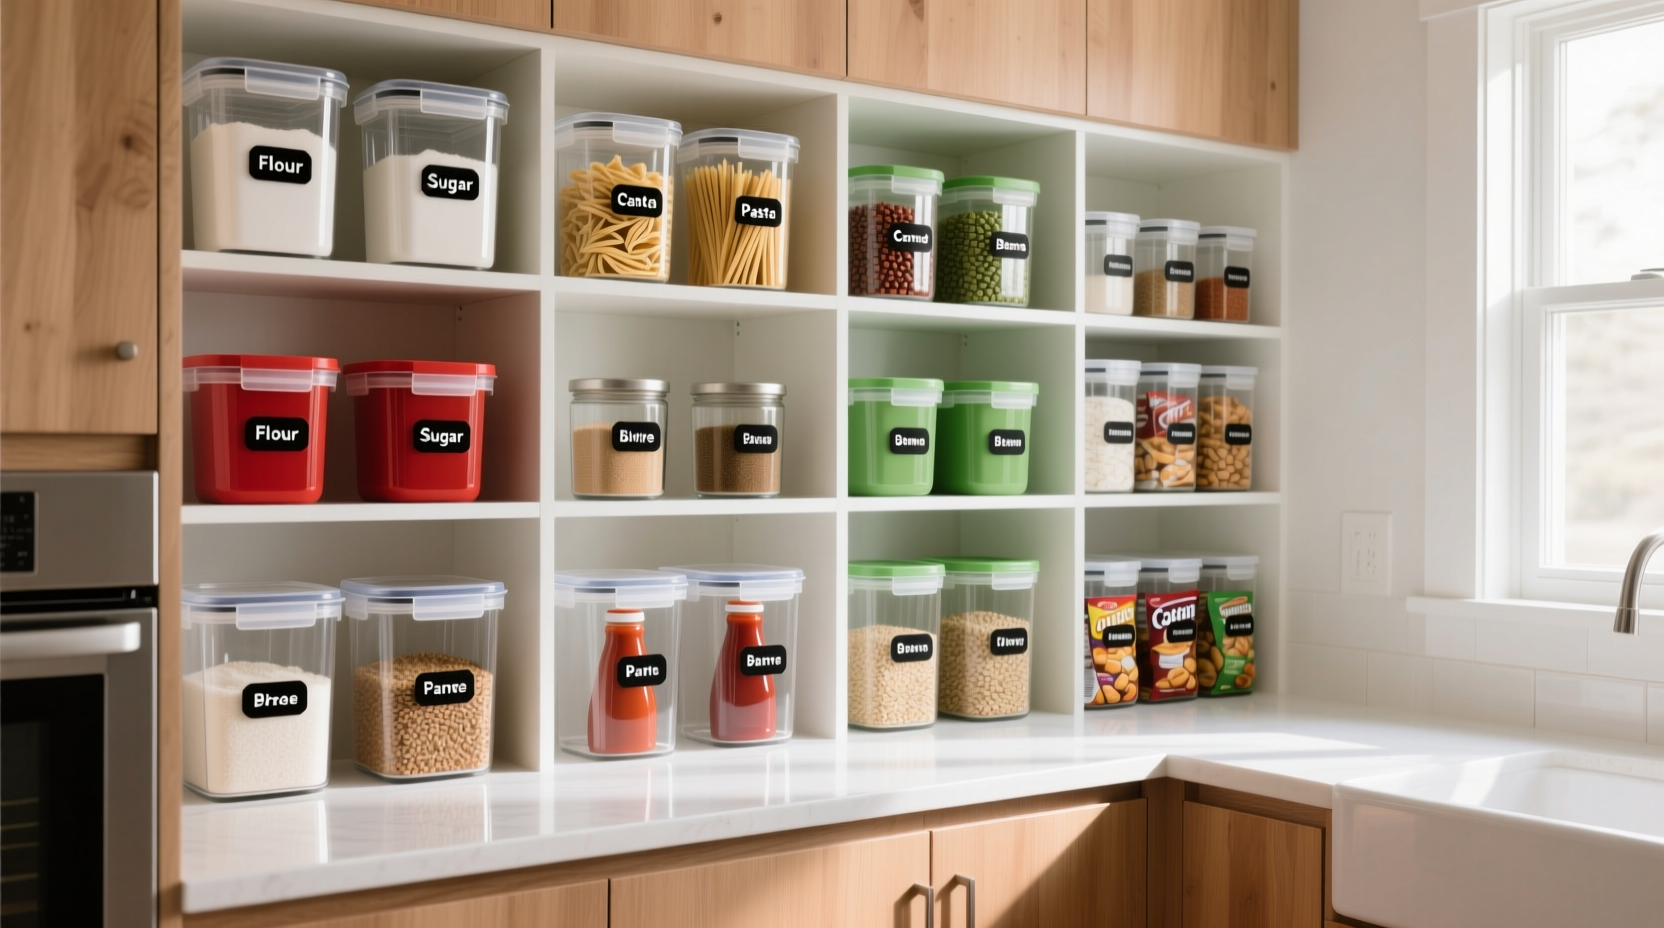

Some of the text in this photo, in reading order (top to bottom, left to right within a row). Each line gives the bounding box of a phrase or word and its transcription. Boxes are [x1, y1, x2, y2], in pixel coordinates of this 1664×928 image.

[259, 155, 303, 174] Flour
[427, 173, 473, 194] Sugar
[256, 425, 298, 441] Flour
[419, 427, 464, 446] Sugar
